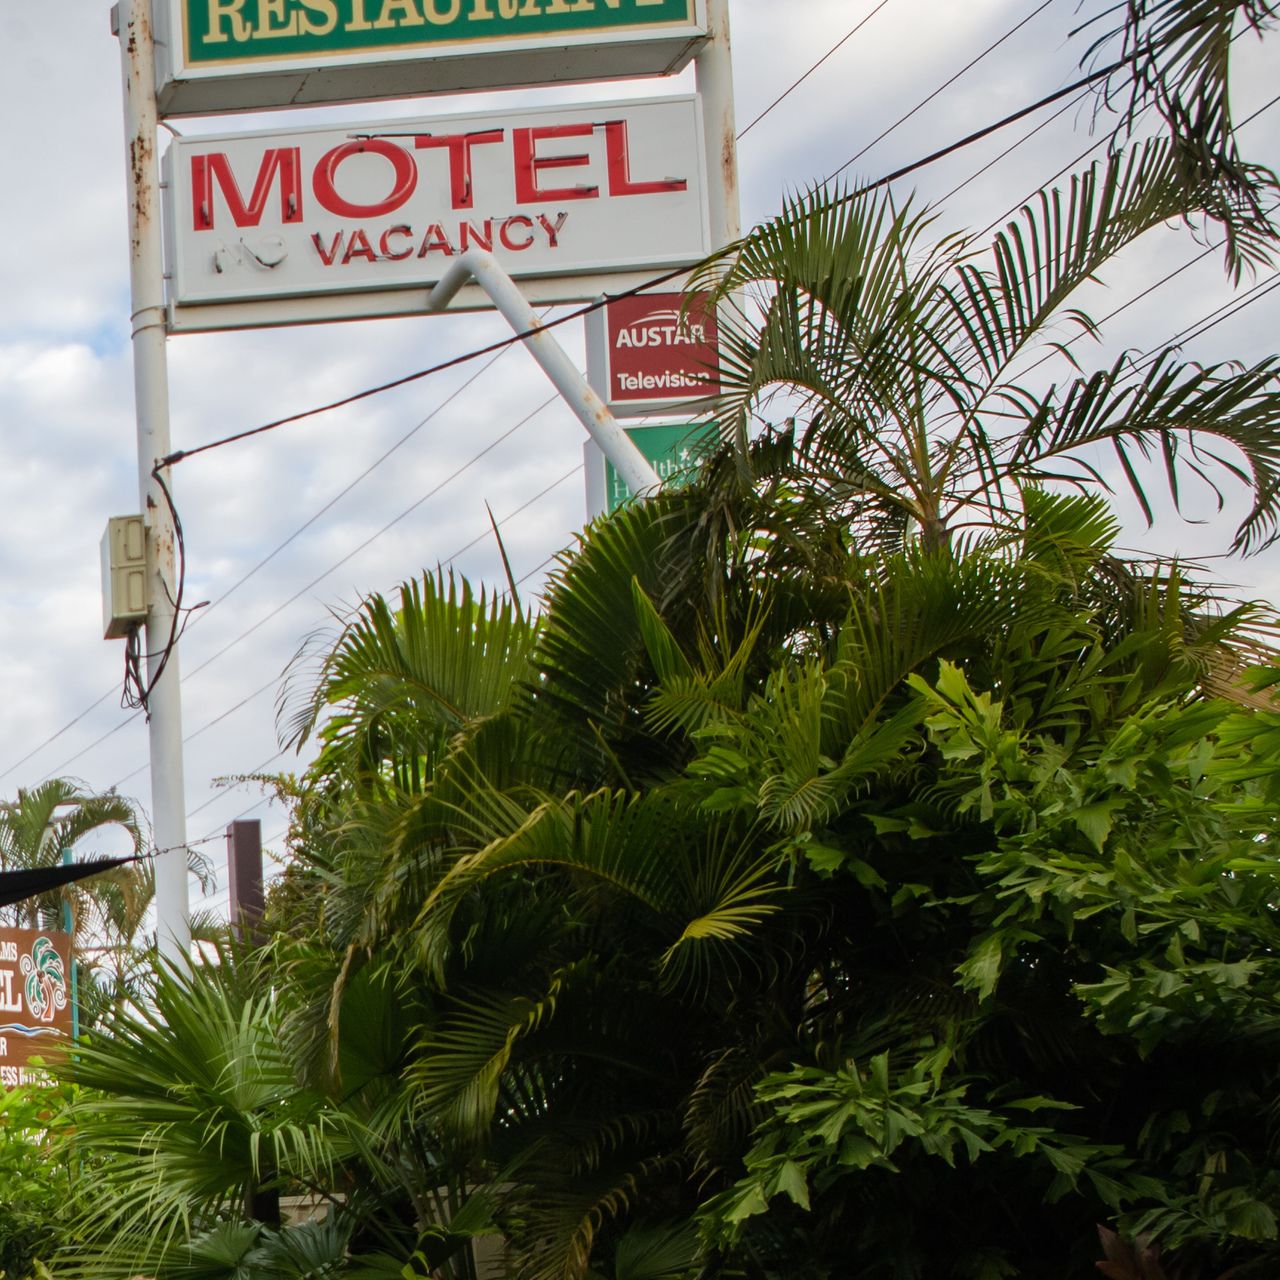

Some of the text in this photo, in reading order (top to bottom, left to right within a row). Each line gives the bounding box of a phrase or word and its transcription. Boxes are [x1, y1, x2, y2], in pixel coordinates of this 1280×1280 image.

[190, 119, 688, 231] MOTEL
[309, 212, 569, 267] VACANCY
[615, 322, 707, 349] AUSTAR
[616, 368, 711, 391] Television
